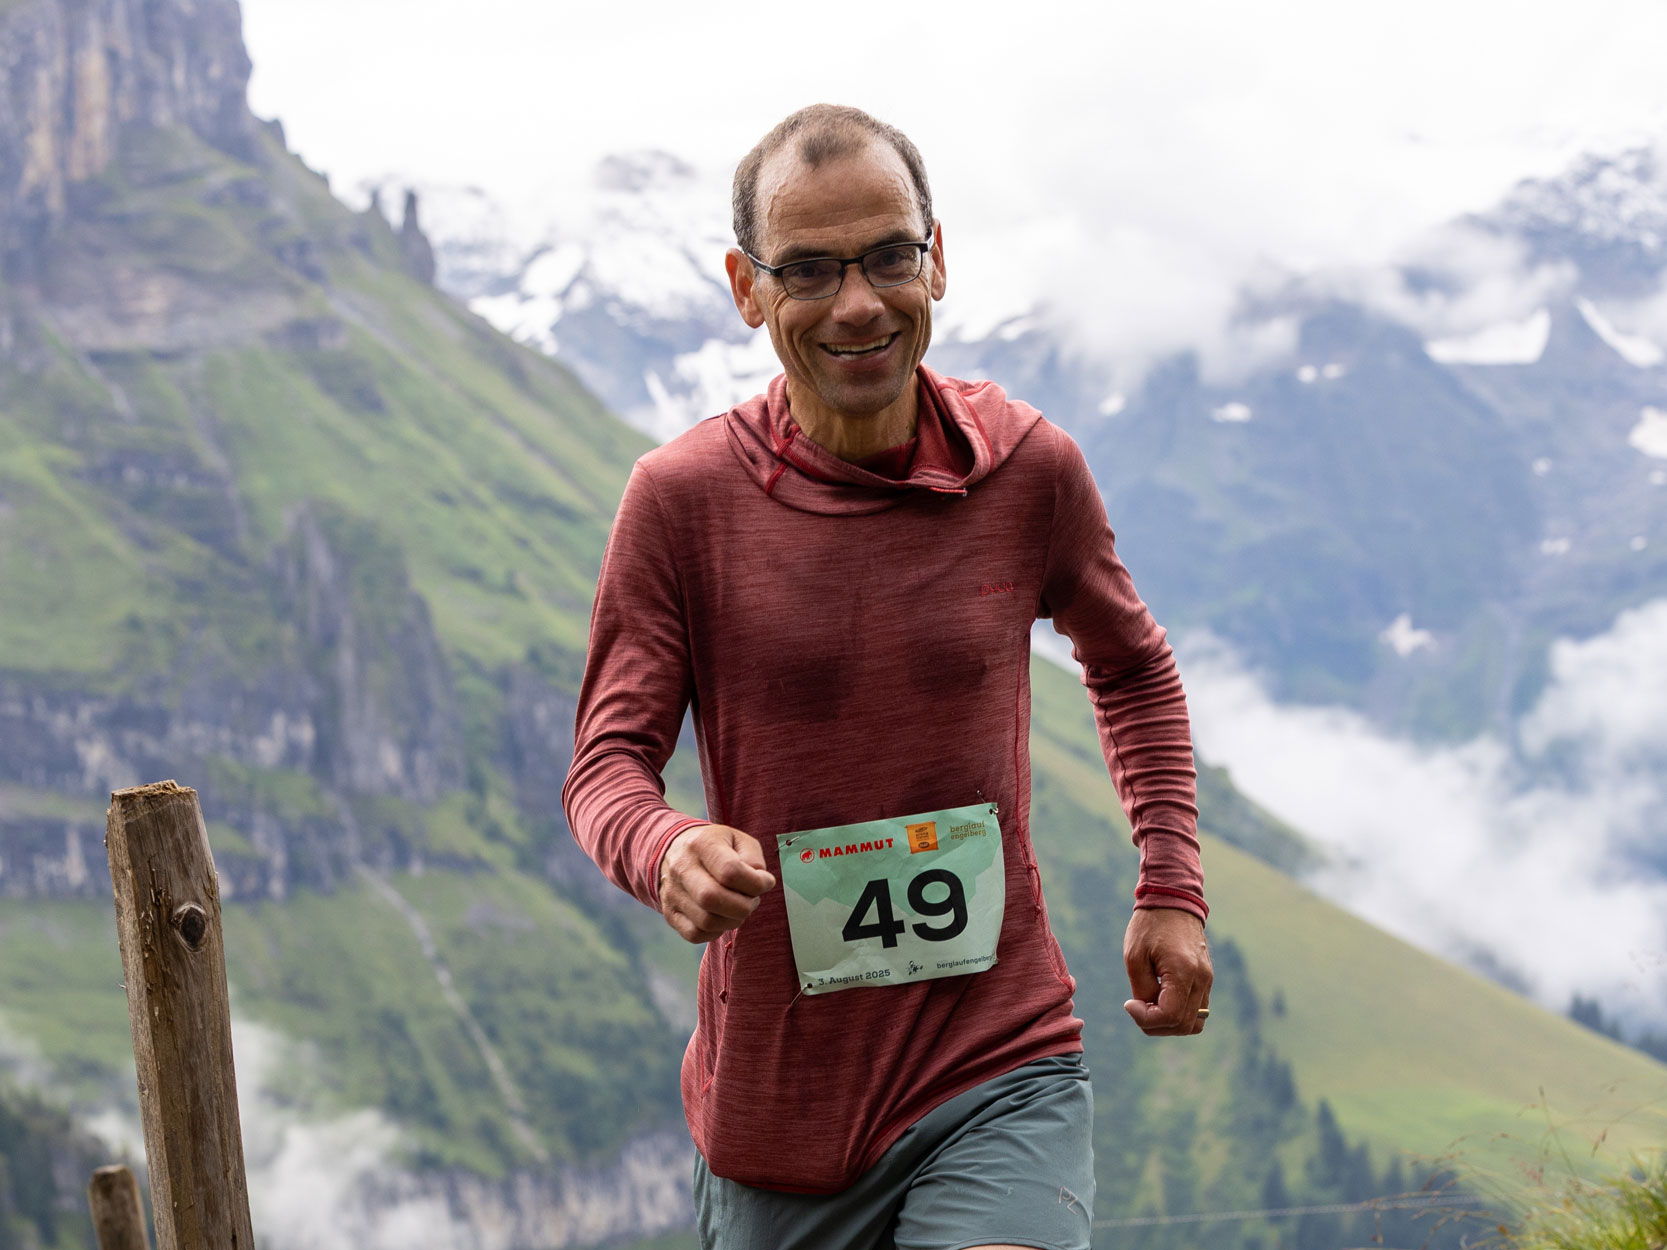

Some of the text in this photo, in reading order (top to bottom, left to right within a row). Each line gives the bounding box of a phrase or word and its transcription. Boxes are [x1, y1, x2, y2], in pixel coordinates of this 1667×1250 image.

[950, 829, 987, 841] engelberg
[819, 838, 894, 858] MAMMUT
[842, 868, 968, 949] 49
[818, 969, 890, 986] 3. August 2025
